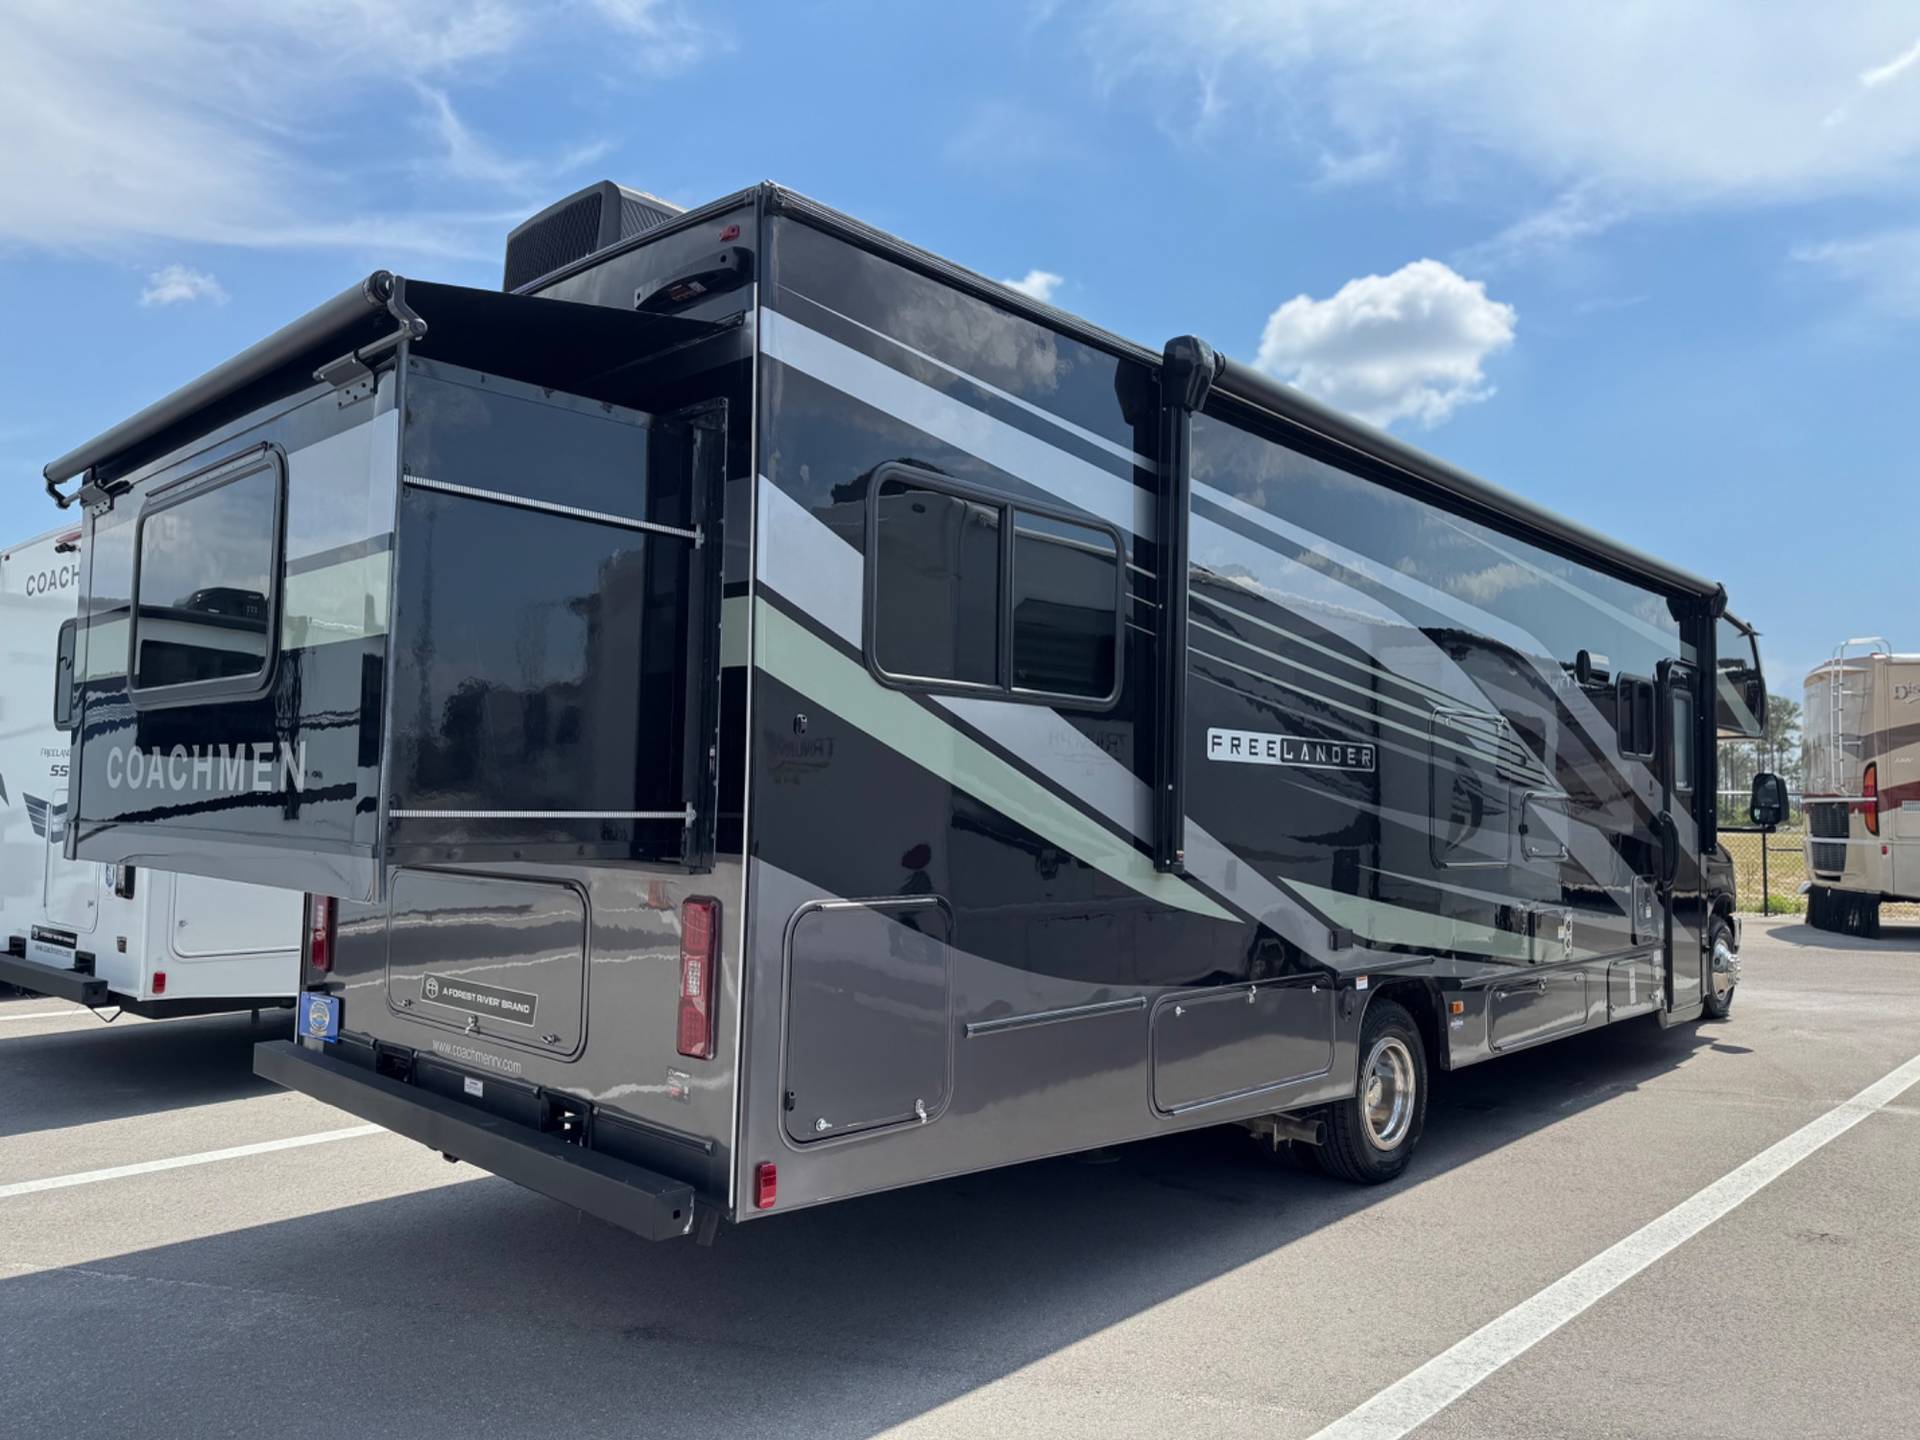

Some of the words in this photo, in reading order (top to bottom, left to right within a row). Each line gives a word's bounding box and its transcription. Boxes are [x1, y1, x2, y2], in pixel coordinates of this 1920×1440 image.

[106, 740, 306, 795] COACHMEN
[1210, 734, 1372, 768] FREELANDER
[442, 987, 450, 996] A
[448, 989, 477, 1002] FOREST
[477, 995, 500, 1007] RIVER
[501, 999, 531, 1014] BRAND
[432, 1039, 523, 1076] www.coachmenrv.com
